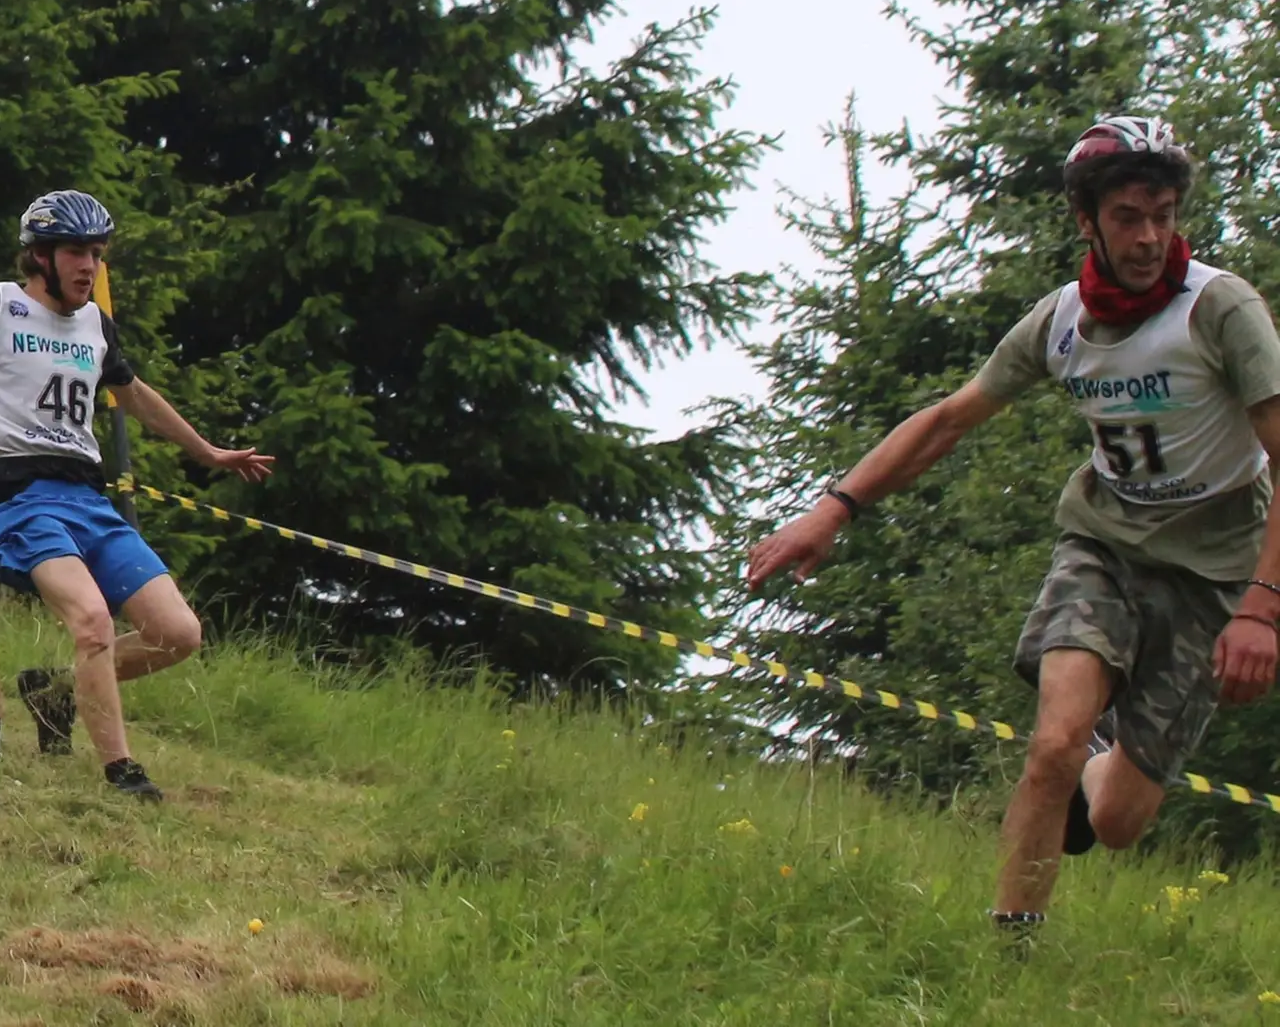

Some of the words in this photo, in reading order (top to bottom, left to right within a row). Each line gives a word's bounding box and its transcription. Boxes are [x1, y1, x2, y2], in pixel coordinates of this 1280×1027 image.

[12, 332, 95, 365] NEWSPORT
[36, 373, 90, 427] 46
[1096, 422, 1166, 478] 51
